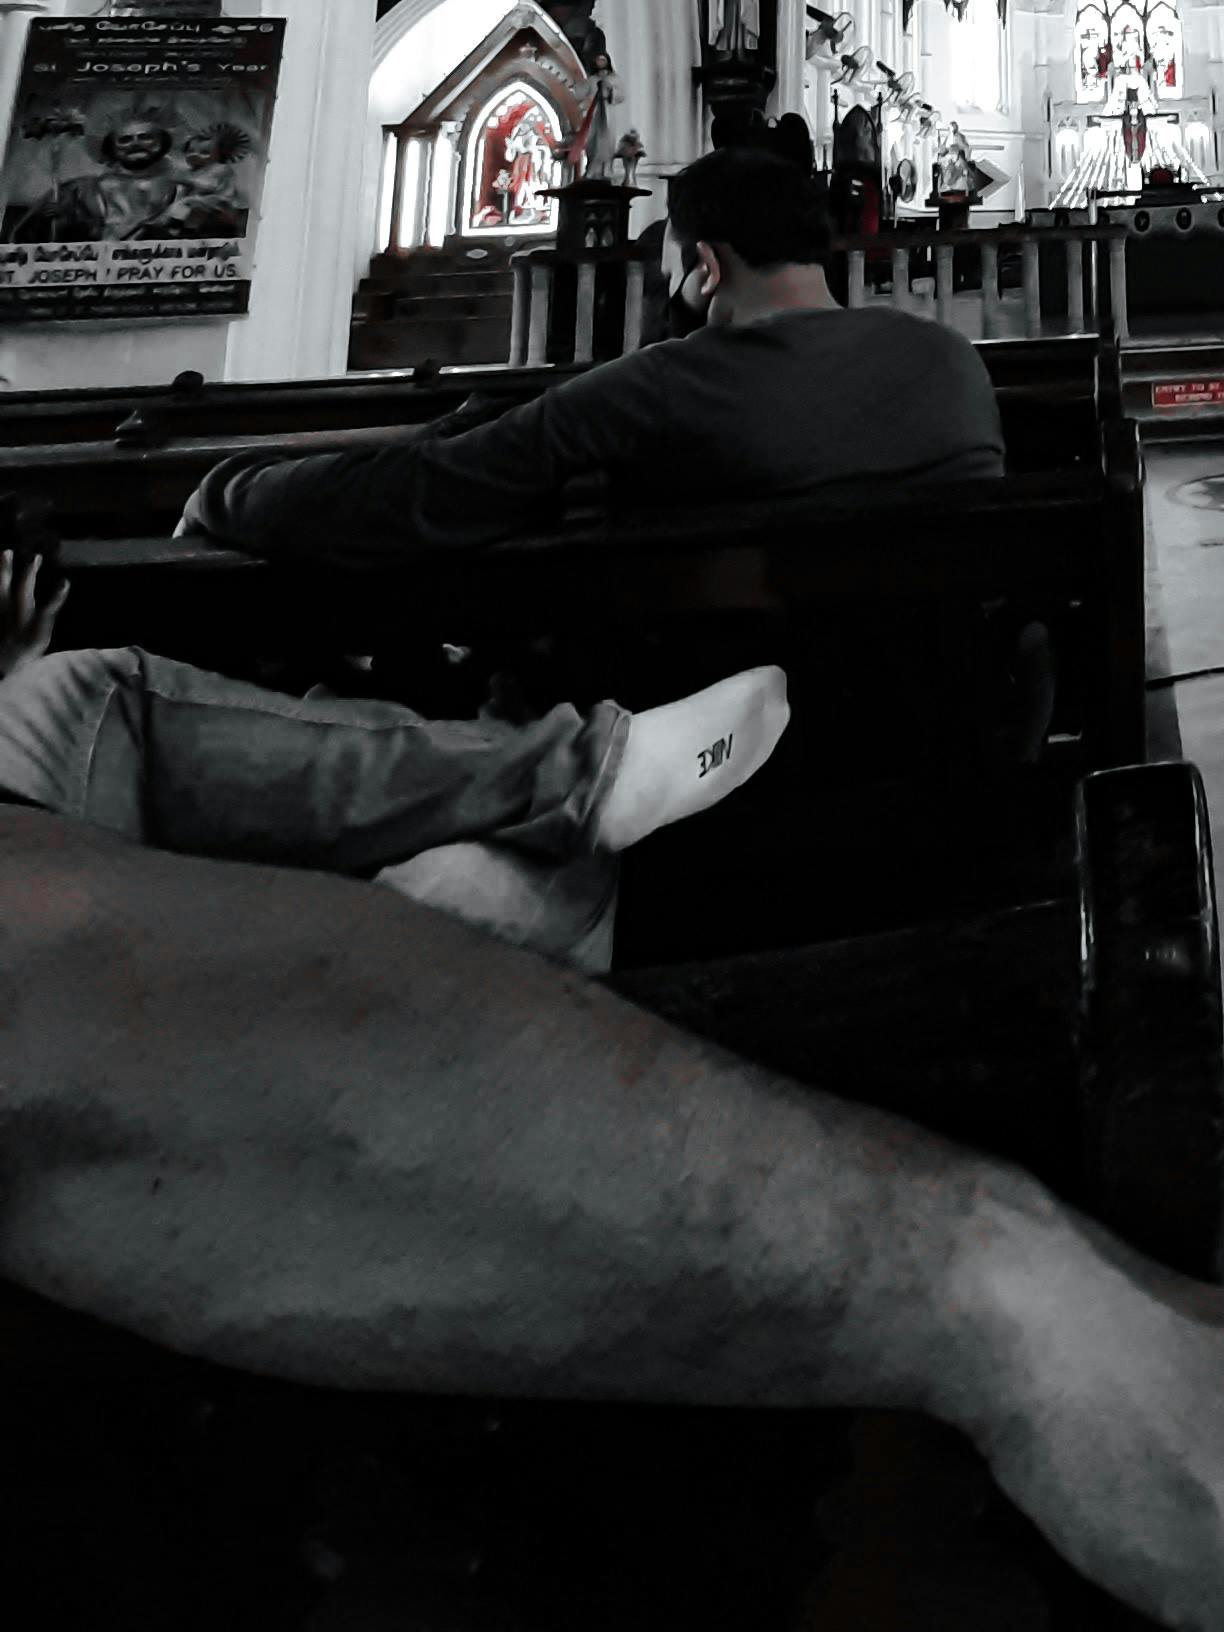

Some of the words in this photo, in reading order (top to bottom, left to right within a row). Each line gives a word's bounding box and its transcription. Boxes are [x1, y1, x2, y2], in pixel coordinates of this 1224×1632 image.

[77, 60, 201, 74] Joseph's
[218, 64, 268, 72] Year
[28, 269, 97, 284] JOSEPH
[117, 266, 164, 281] PRAY
[170, 264, 206, 279] FOR
[1192, 383, 1205, 391] TO
[697, 733, 733, 779] NIKE
